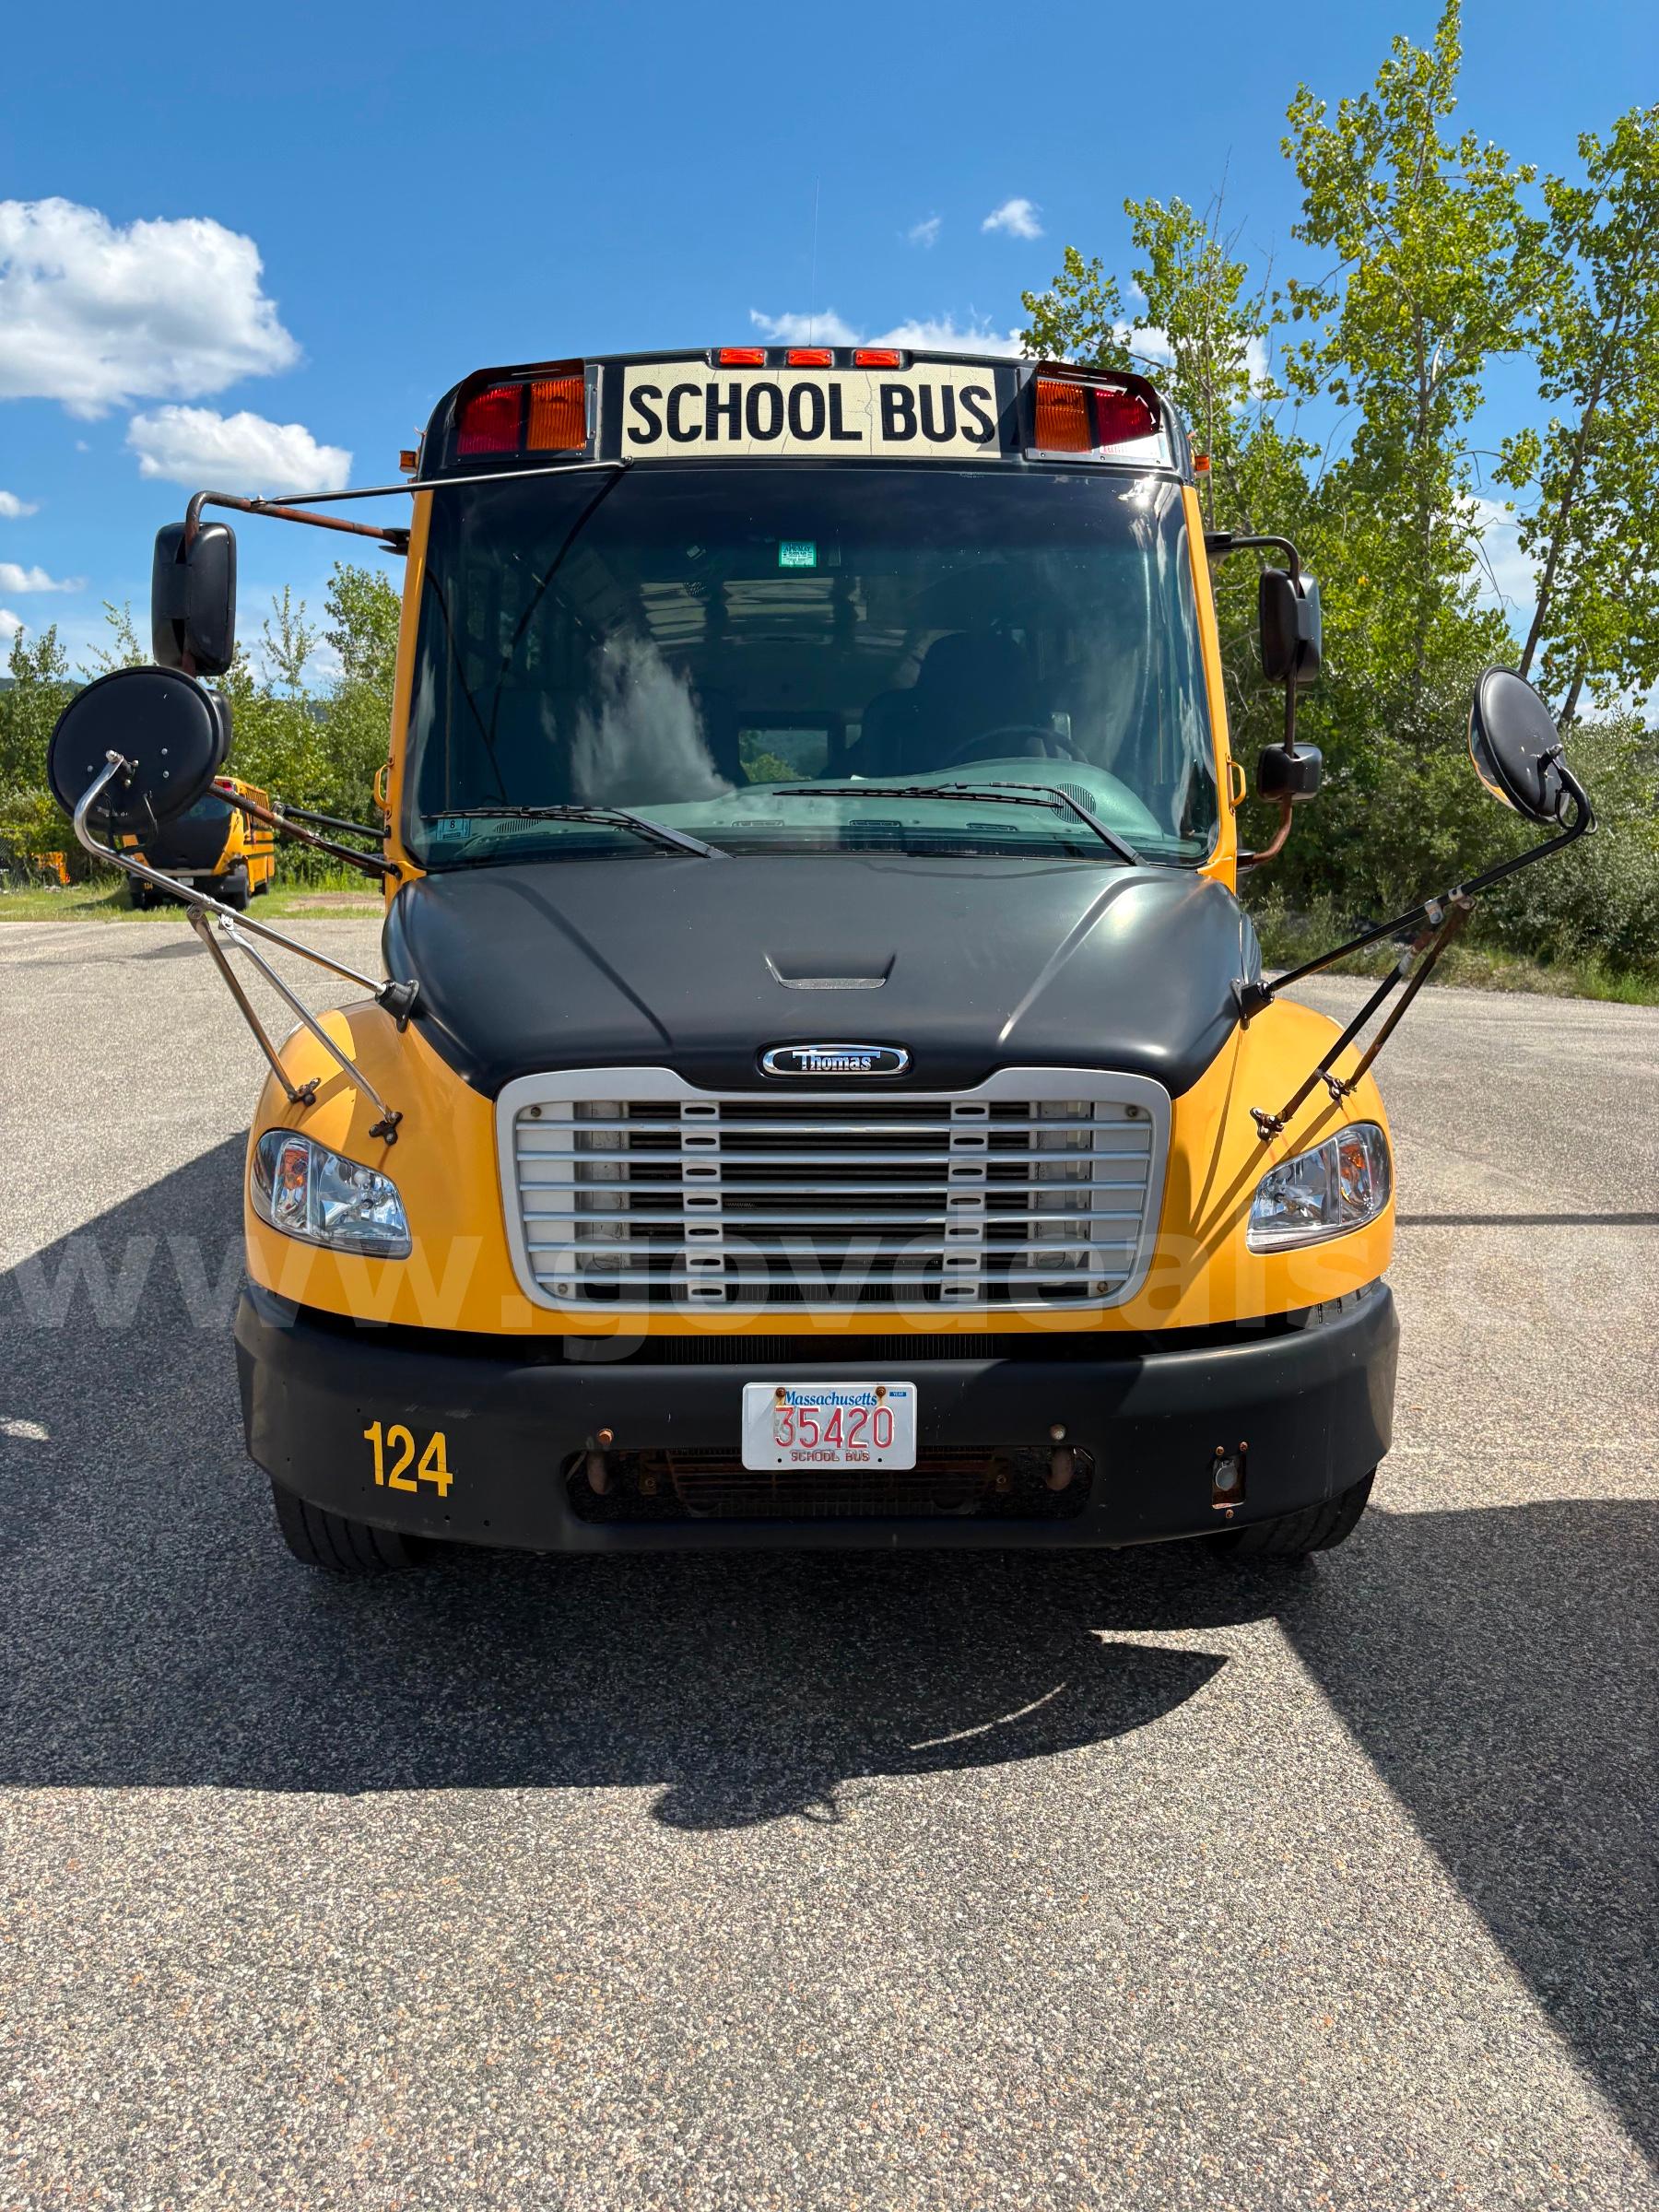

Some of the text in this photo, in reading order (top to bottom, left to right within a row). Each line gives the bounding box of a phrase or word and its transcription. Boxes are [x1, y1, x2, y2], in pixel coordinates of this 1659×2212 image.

[627, 382, 996, 444] SCHOOL BUS
[793, 1050, 880, 1071] Thomas
[783, 1391, 877, 1406] Massachusetts
[774, 1406, 894, 1448] 35420
[363, 1420, 453, 1497] 124
[791, 1451, 871, 1462] SCHOOL BUS
